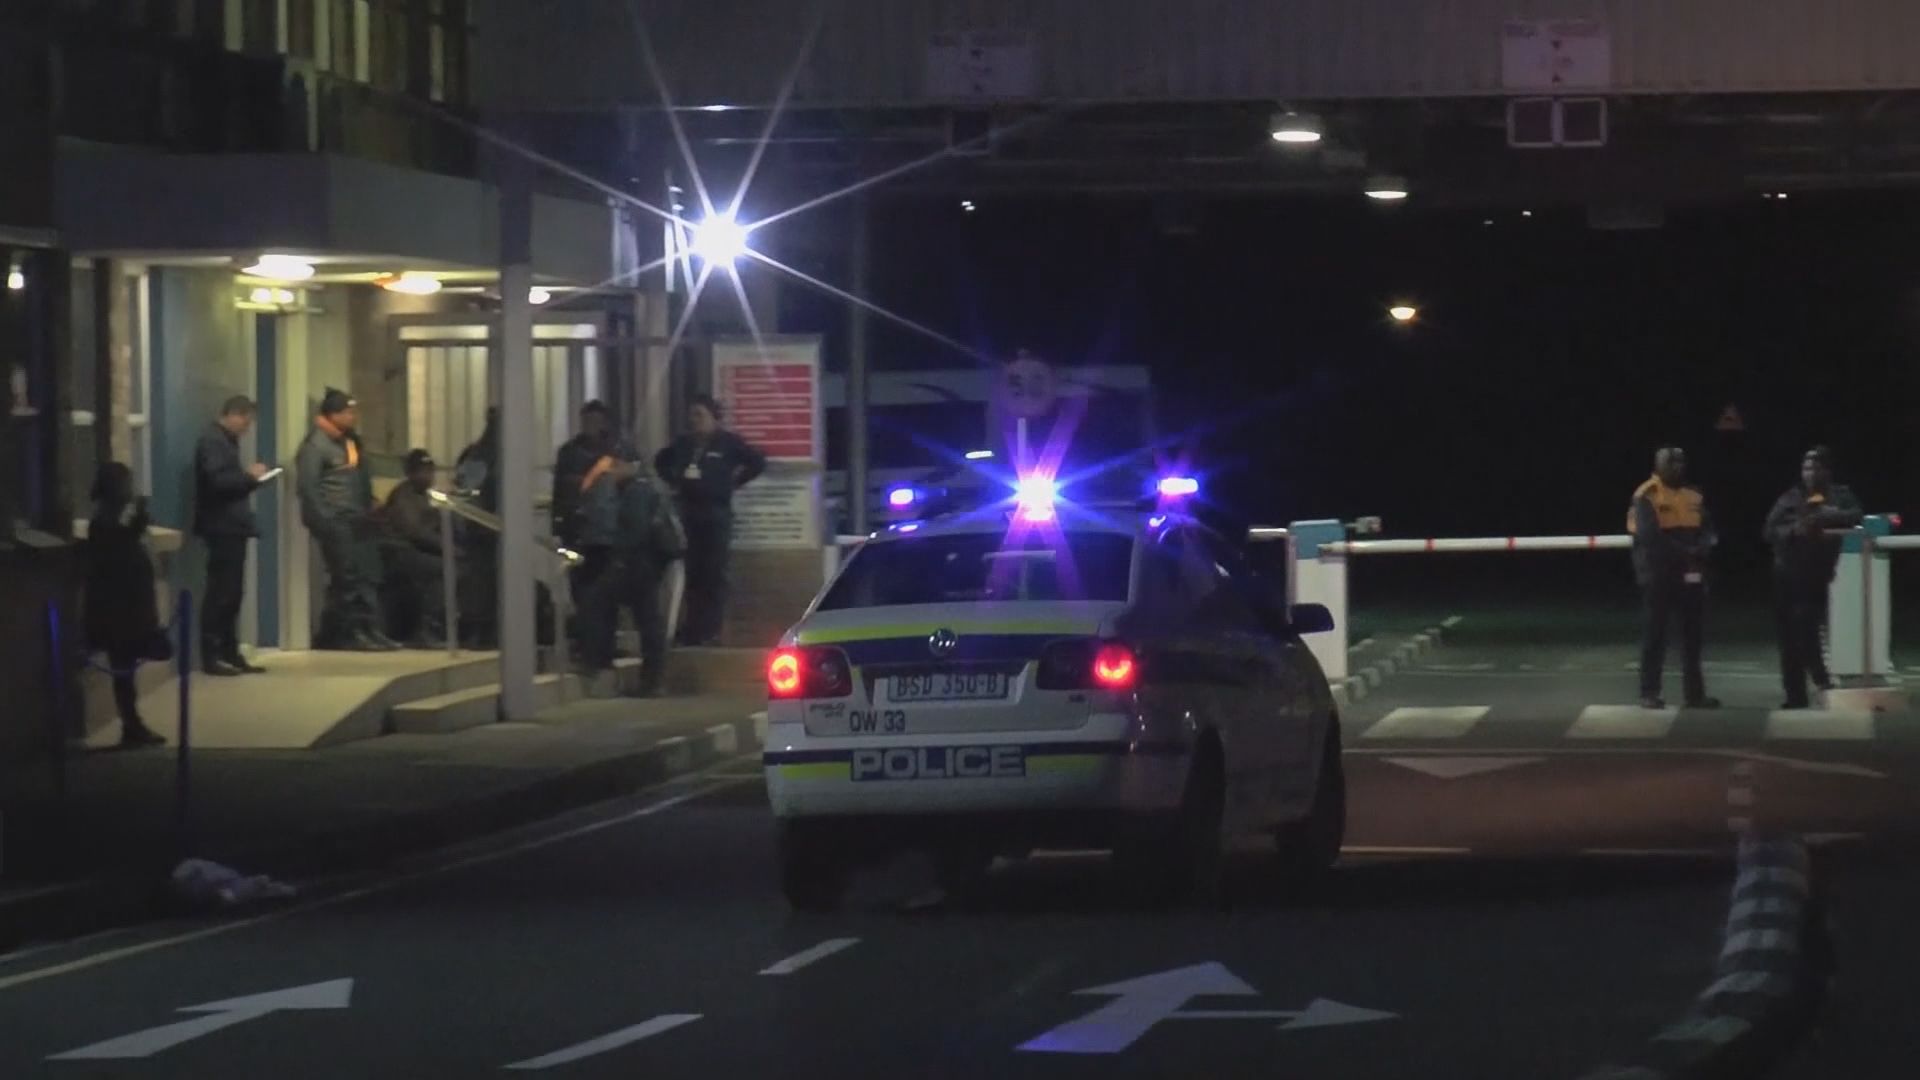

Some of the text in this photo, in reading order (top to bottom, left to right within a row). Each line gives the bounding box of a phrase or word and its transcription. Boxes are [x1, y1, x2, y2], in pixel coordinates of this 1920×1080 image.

[849, 709, 906, 732] OW 33
[852, 745, 1024, 781] POLICE
